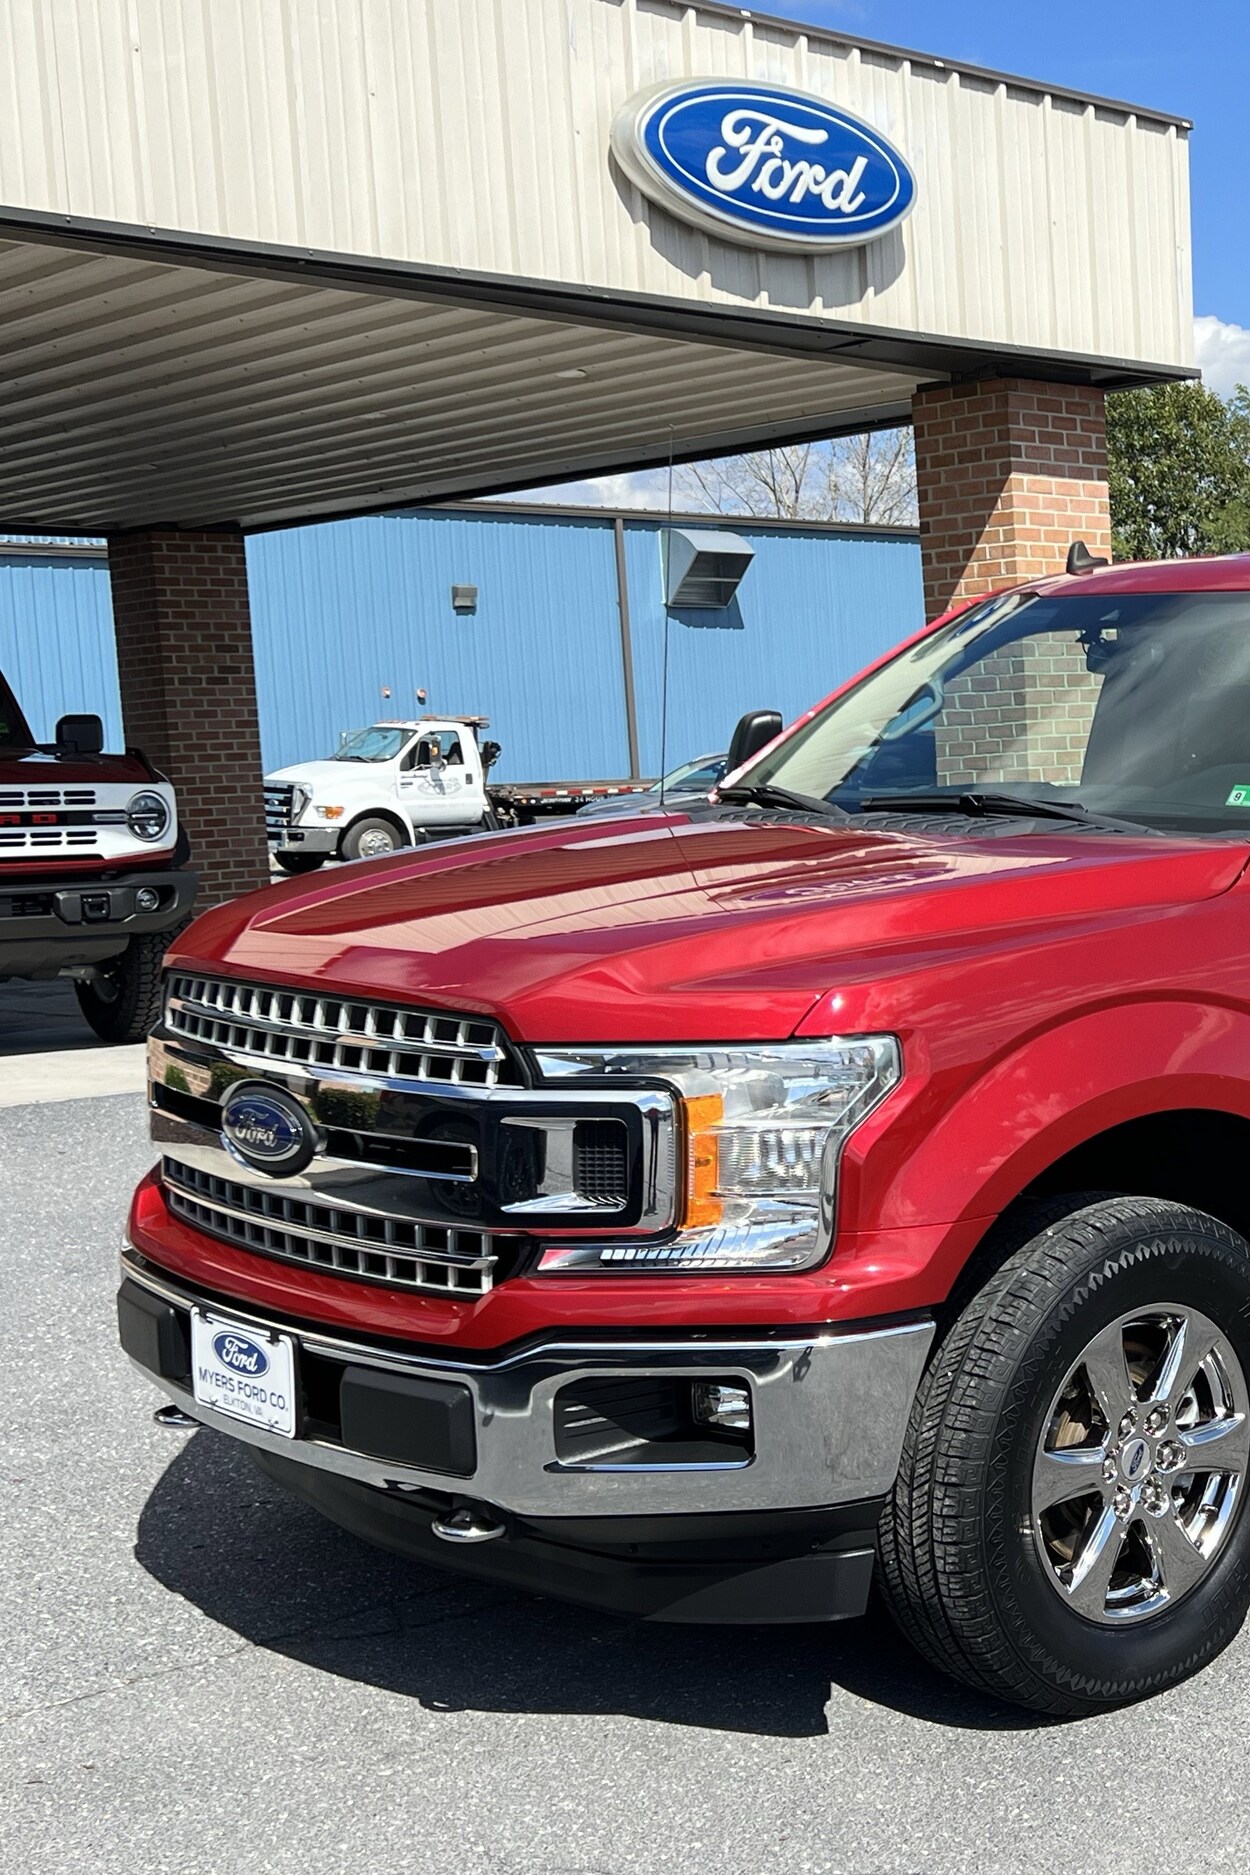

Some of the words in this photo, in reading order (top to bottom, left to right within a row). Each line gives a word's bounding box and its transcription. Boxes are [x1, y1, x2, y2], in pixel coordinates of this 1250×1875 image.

[705, 109, 869, 214] Ford
[1233, 792, 1243, 802] 9
[234, 1108, 279, 1148] Ford
[222, 1336, 258, 1372] Ford
[199, 1366, 236, 1393] MYERS
[236, 1380, 267, 1403] FORD
[269, 1392, 289, 1412] CO.
